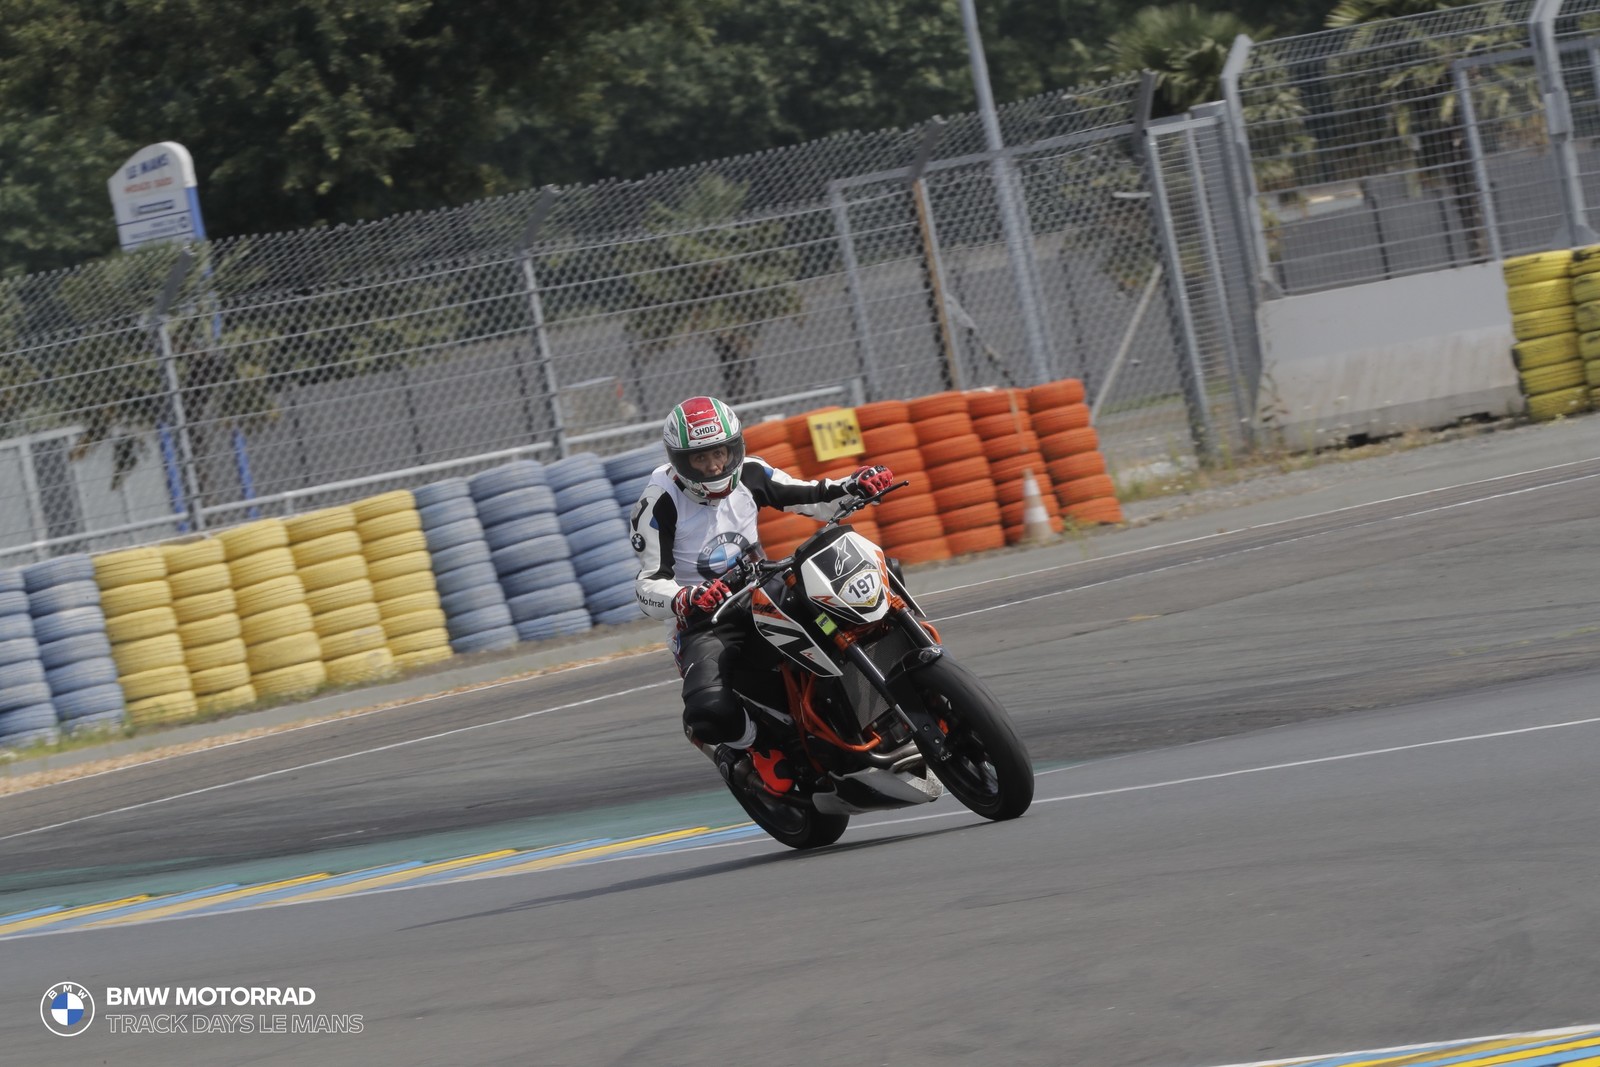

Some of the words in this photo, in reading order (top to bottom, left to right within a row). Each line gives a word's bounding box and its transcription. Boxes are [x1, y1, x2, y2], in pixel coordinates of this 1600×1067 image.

[694, 425, 717, 437] SHOEI
[702, 534, 743, 556] BMW
[848, 573, 875, 599] 197
